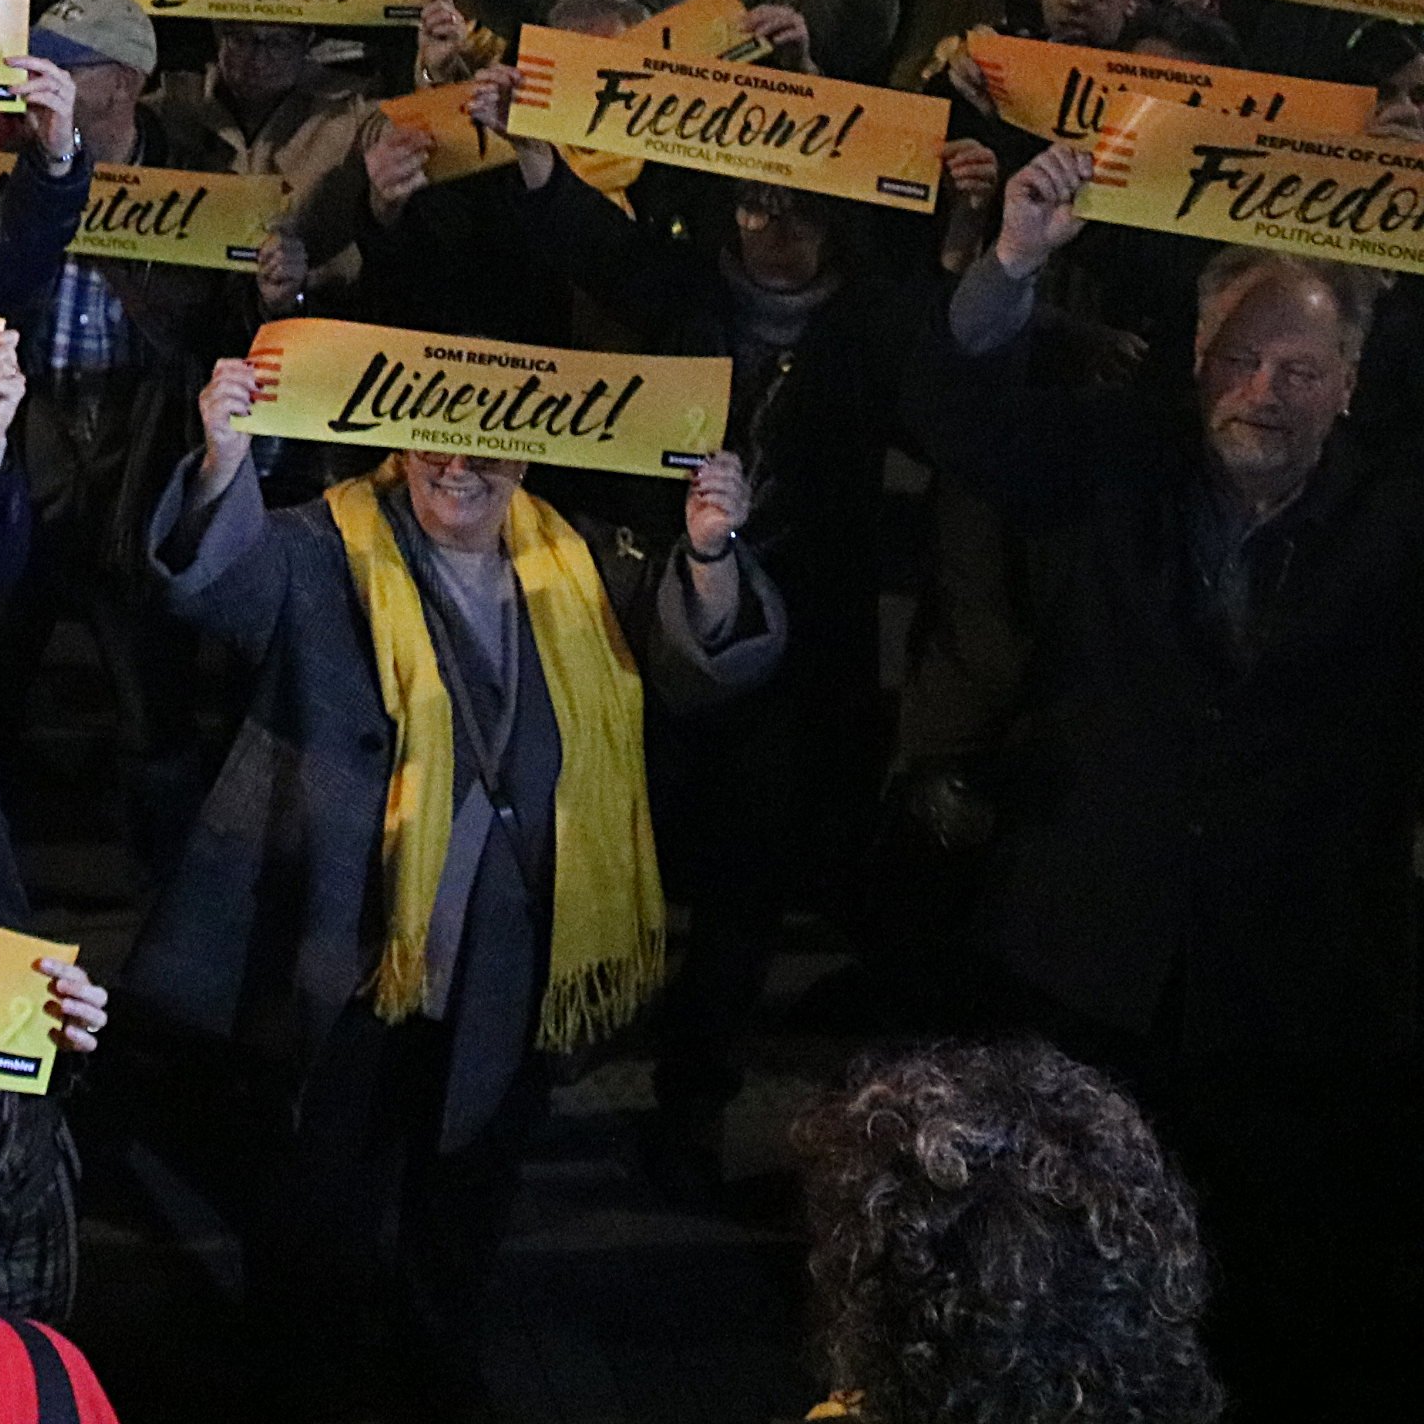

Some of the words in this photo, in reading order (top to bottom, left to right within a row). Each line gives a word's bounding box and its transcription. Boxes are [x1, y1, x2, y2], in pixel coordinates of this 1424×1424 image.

[642, 56, 705, 79] REPUBLIC
[708, 67, 730, 85] OF
[733, 71, 815, 99] CATALONIA
[586, 70, 855, 157] Freedom!
[644, 138, 712, 164] POLITICAL
[715, 149, 793, 176] PRISONERS
[1256, 132, 1342, 158] REPUBLIC
[1345, 145, 1372, 164] OF
[1255, 221, 1342, 253] POLITICAL
[424, 346, 465, 364] SOM
[468, 350, 558, 374] REPÚBLICA
[328, 352, 643, 442] Llibertat!
[411, 428, 473, 448] PRESOS
